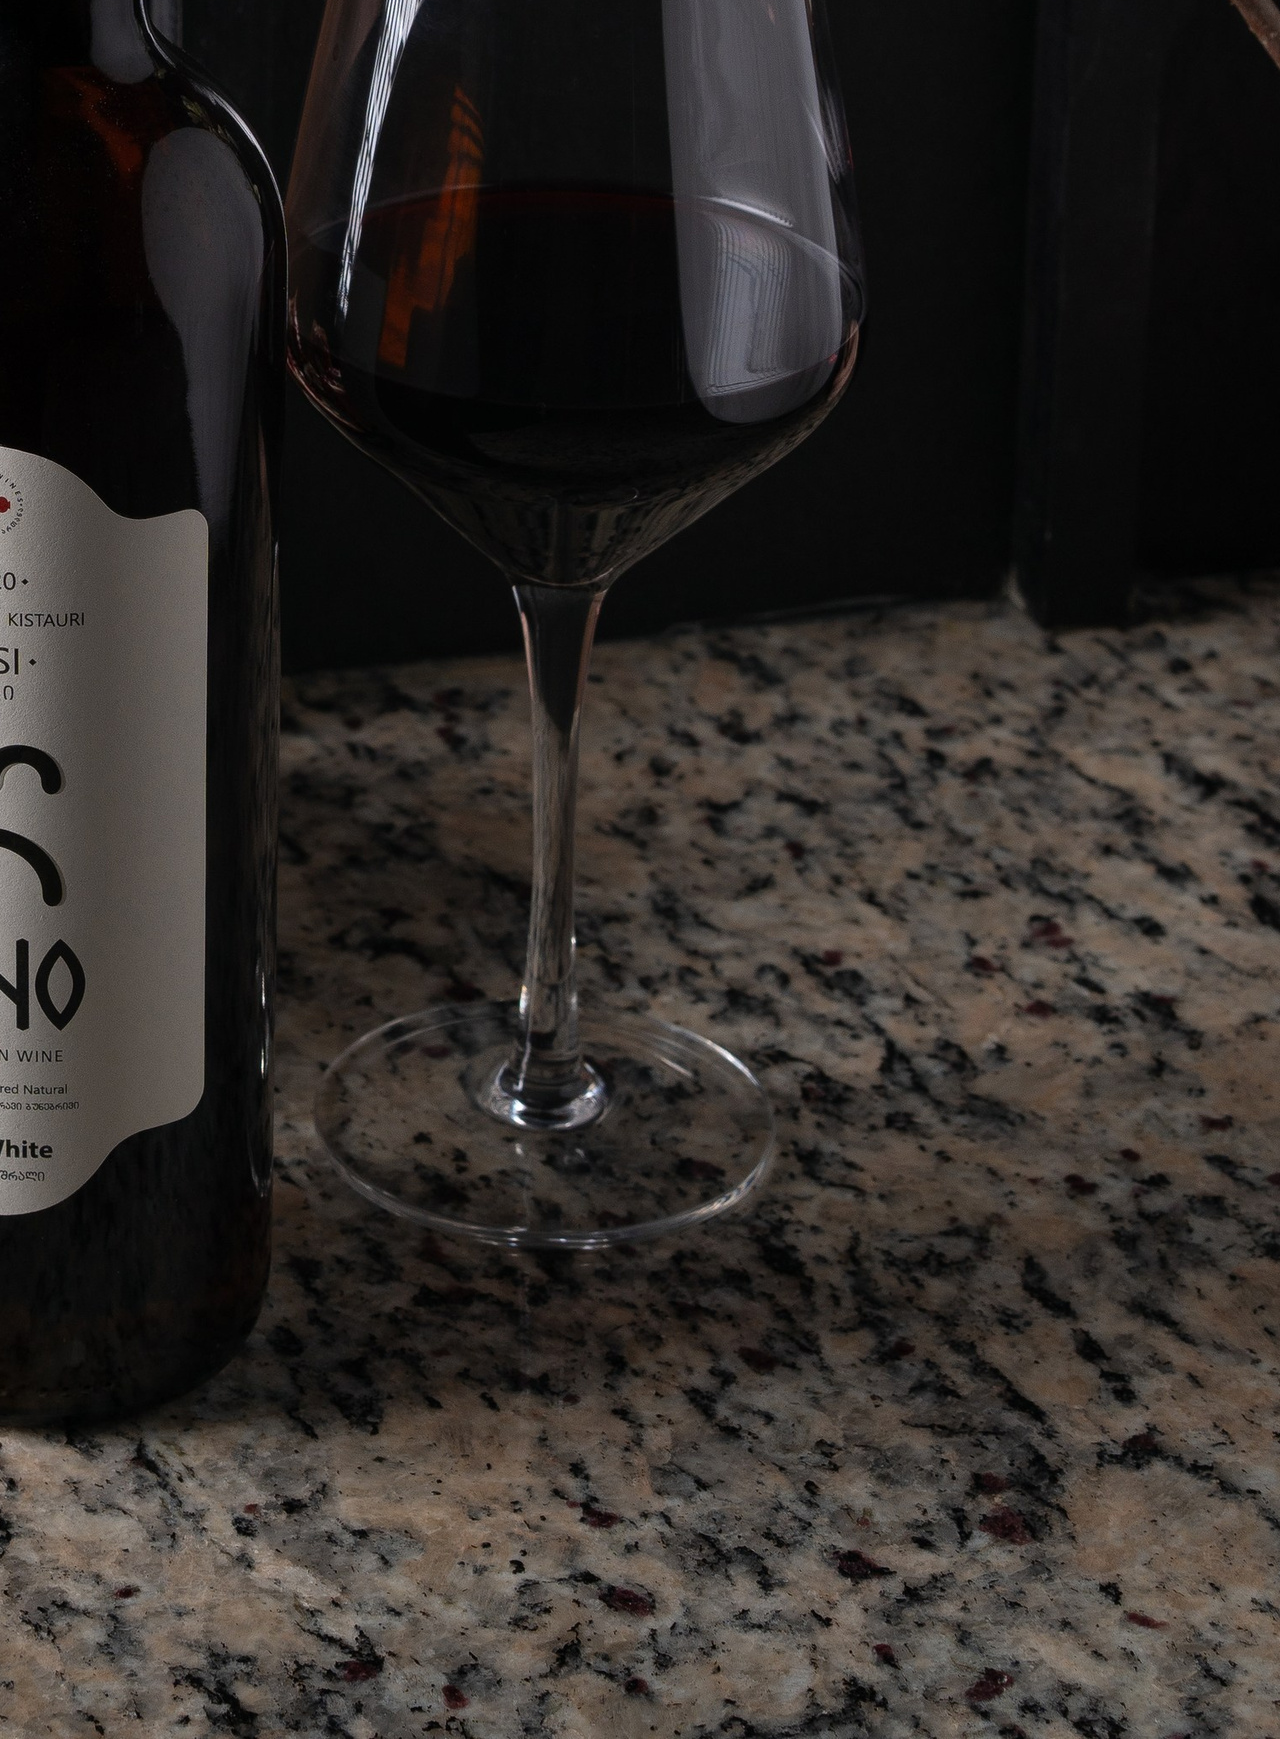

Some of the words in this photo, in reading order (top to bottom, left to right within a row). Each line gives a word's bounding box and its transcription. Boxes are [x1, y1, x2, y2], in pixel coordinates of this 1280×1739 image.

[9, 612, 86, 628] KISTAURI
[17, 1050, 64, 1063] WINE
[24, 1084, 68, 1095] Natural
